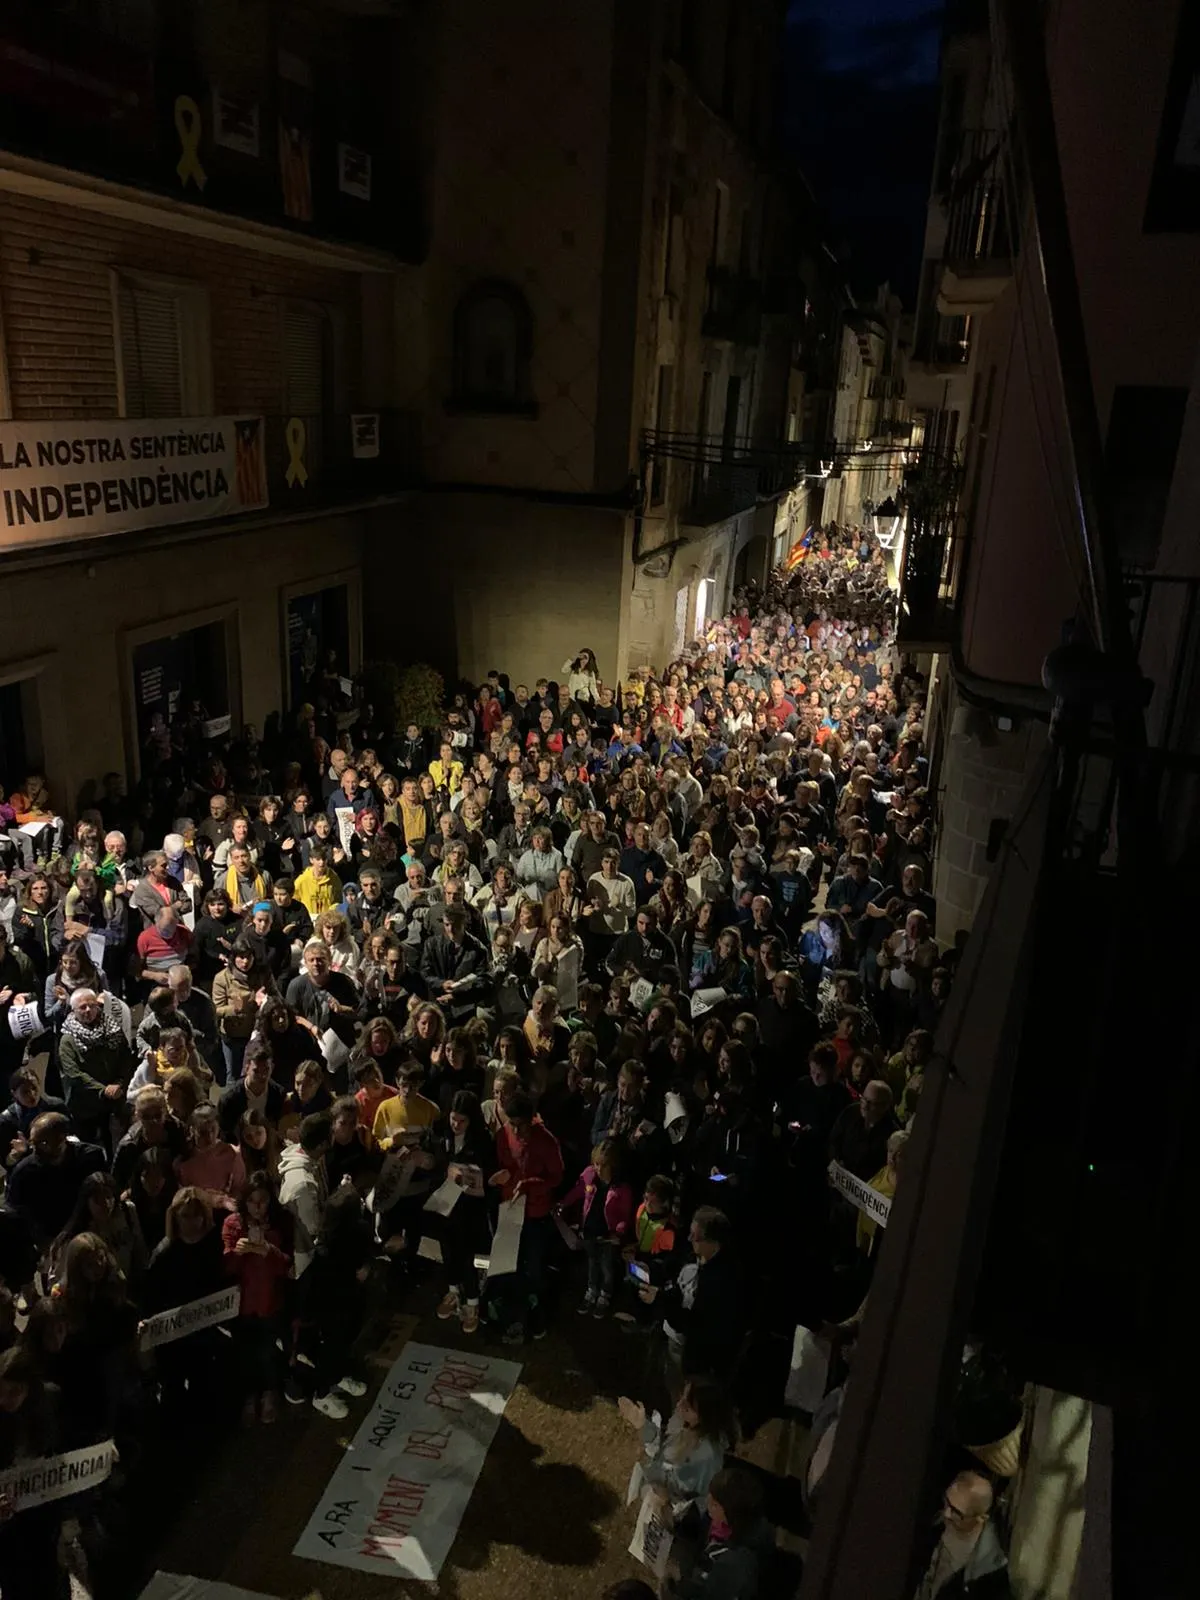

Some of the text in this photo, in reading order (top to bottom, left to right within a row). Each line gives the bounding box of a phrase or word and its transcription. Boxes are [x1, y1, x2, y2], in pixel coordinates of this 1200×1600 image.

[0, 429, 226, 469] LA NOSTRA SENTÈNCIA
[4, 465, 229, 526] INDEPENDÈNCIA
[835, 1170, 889, 1219] REINCIDÈNCI
[317, 1499, 358, 1549] ARA
[367, 1404, 401, 1448] AQUÍ
[407, 1360, 433, 1375] EL
[358, 1355, 490, 1562] MOMENT DEL POBLE
